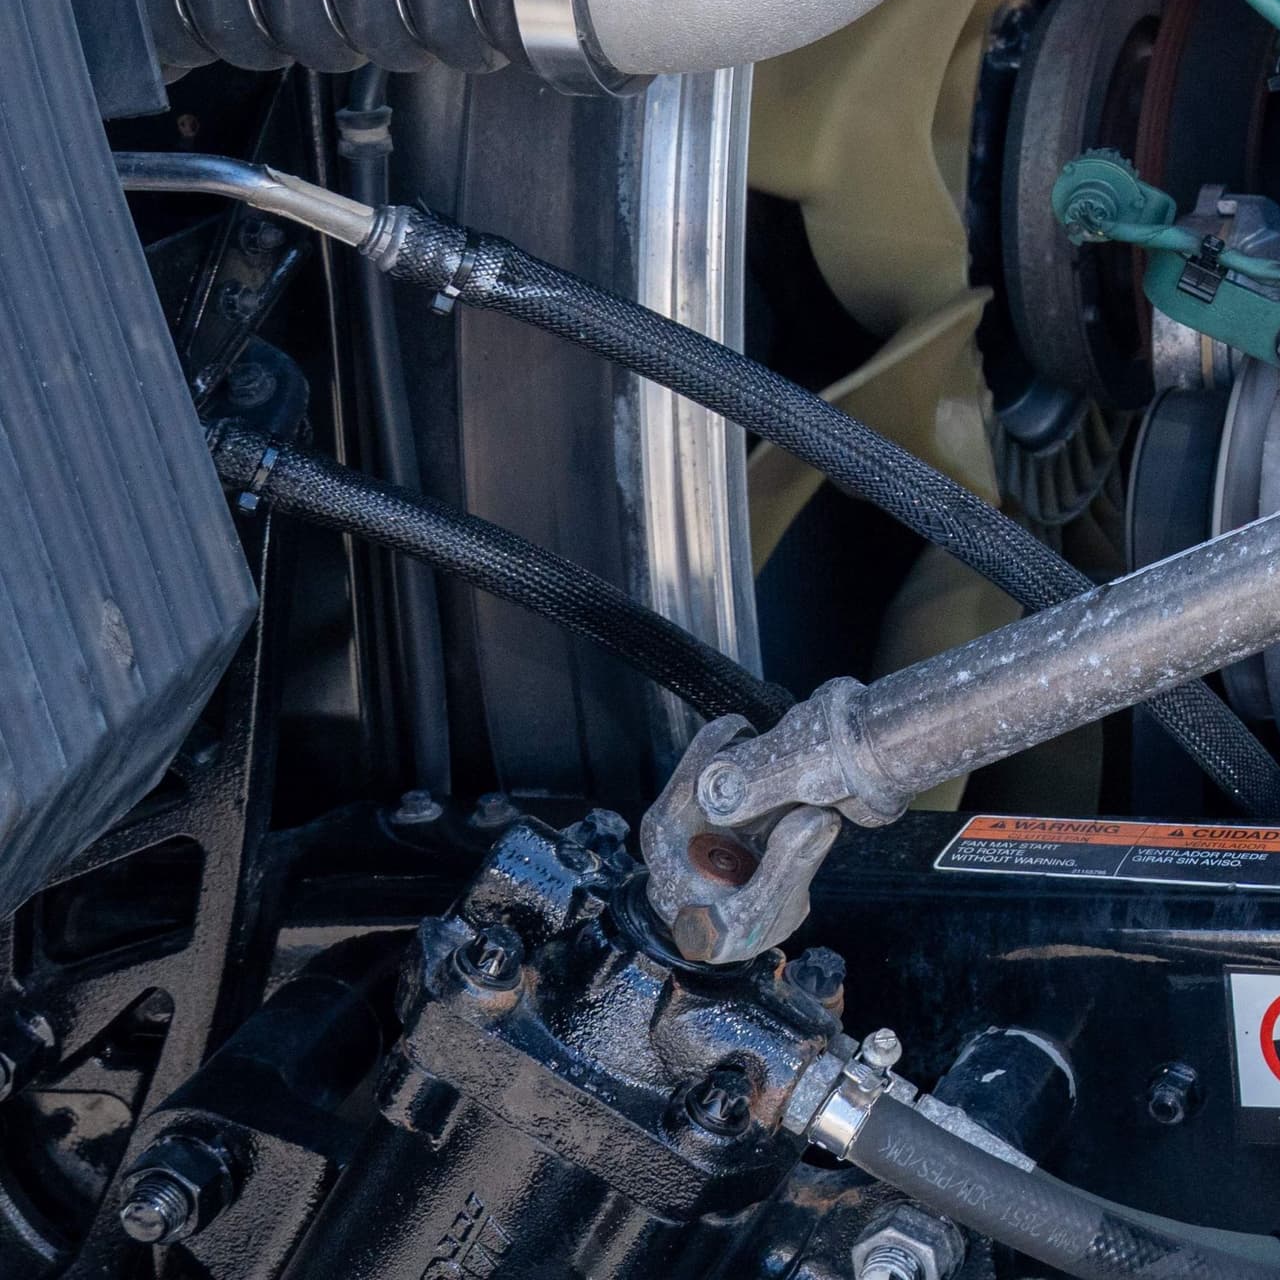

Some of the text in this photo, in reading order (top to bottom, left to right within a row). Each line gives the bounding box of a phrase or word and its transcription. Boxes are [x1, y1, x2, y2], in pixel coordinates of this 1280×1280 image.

[1014, 820, 1121, 834] WARNING
[957, 846, 1026, 856] TO ROTATE
[960, 840, 988, 848] FAN
[1018, 843, 1061, 851] START
[1184, 840, 1267, 850] VENTILADOR
[951, 853, 1079, 867] WITHOUT WARNING.
[1137, 848, 1269, 861] VENTILADOR PUEDE
[1131, 855, 1243, 867] GIRAR SIN AVISO.
